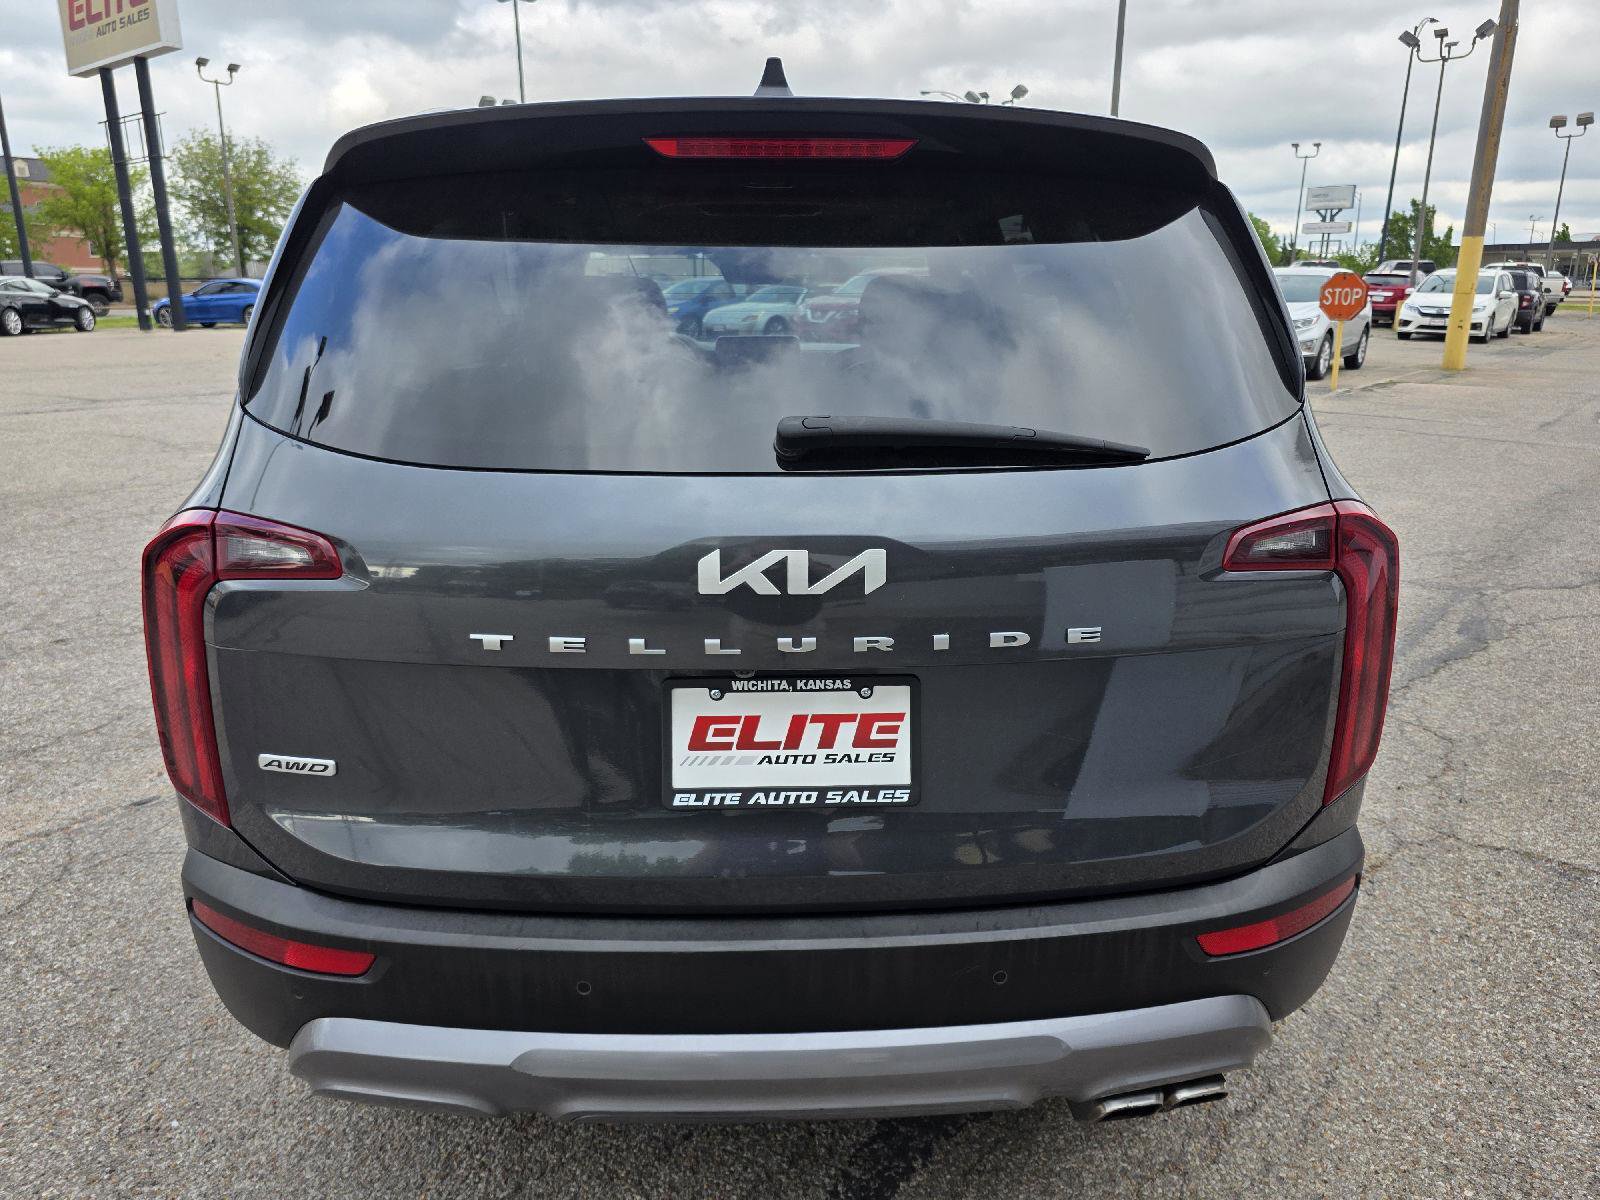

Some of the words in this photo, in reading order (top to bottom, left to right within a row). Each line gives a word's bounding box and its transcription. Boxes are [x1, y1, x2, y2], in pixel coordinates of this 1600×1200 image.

[68, 0, 149, 31] ELI
[96, 20, 117, 38] AUTO
[120, 8, 149, 29] SALES
[1323, 288, 1363, 306] STOP
[698, 548, 887, 595] KIA
[469, 626, 1102, 655] TELLURIDE
[731, 680, 793, 692] WICHITA,
[796, 679, 852, 690] KANSAS
[687, 712, 907, 752] ELITE
[264, 760, 329, 773] AWD
[757, 754, 816, 766] AUTO
[824, 752, 896, 764] SALES
[672, 792, 742, 806] ELITE
[747, 791, 819, 805] AUTO
[825, 789, 911, 804] SALES
